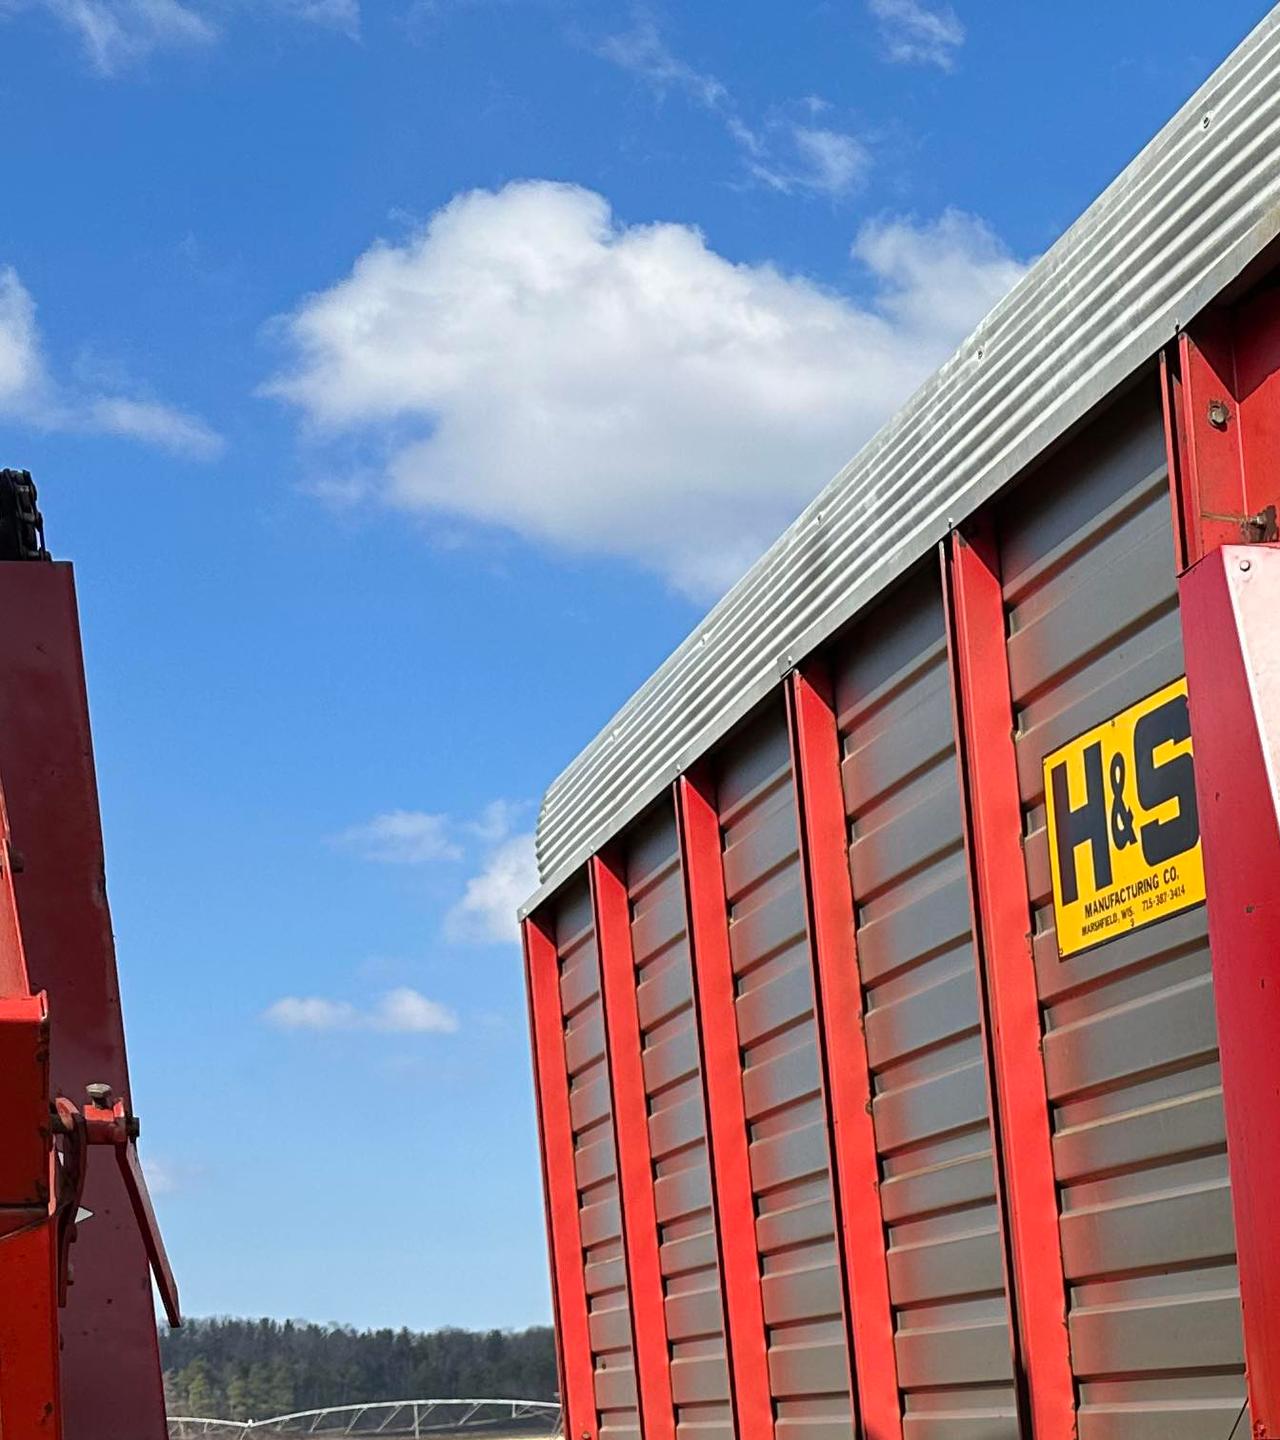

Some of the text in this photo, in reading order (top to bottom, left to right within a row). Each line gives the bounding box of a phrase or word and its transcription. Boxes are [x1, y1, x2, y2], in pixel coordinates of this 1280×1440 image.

[1051, 694, 1199, 905] H&S
[1084, 866, 1180, 919] MANUFACTURING CO.
